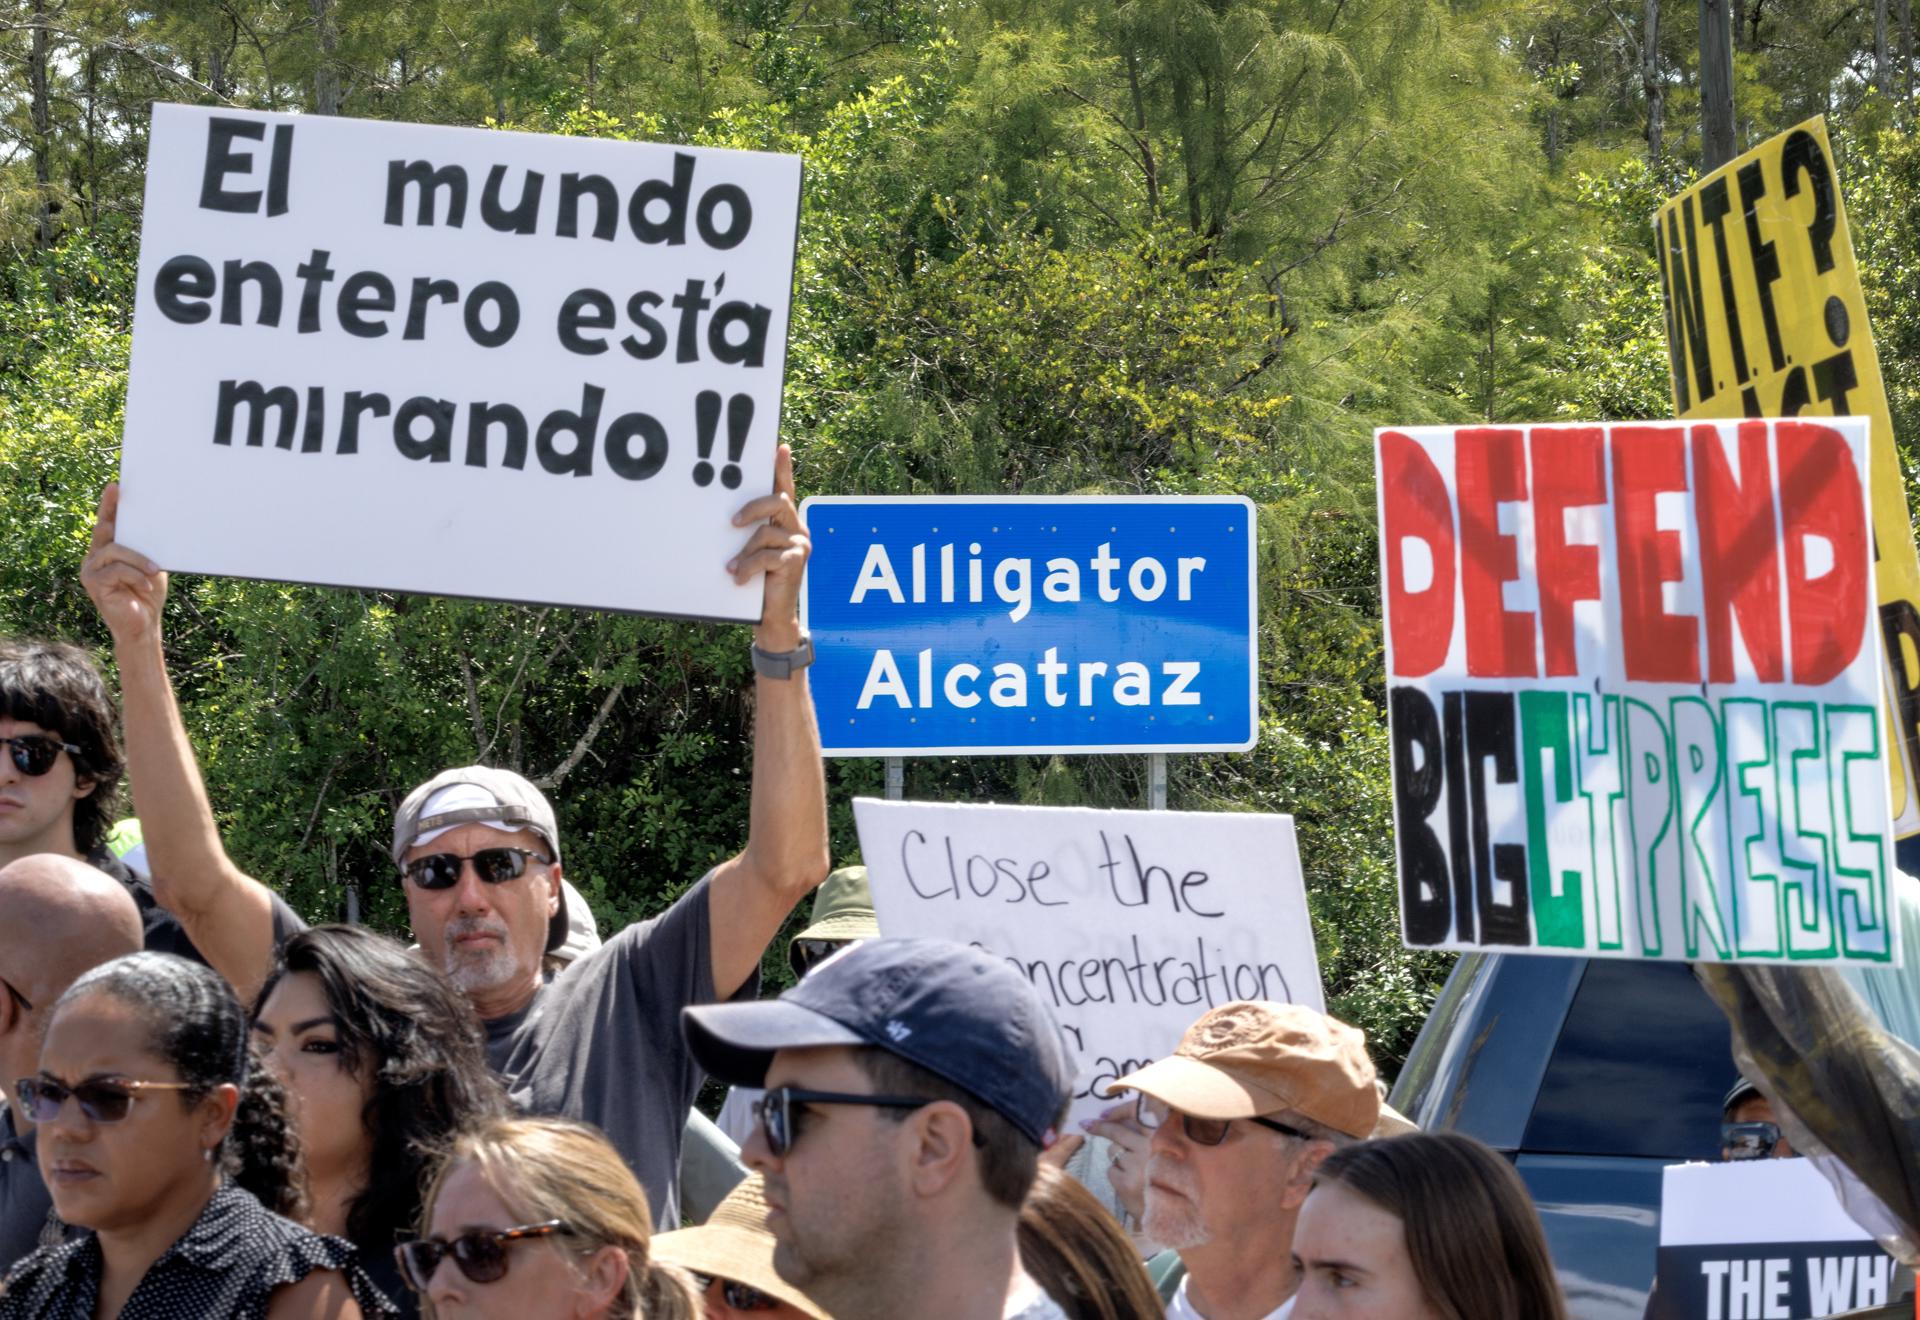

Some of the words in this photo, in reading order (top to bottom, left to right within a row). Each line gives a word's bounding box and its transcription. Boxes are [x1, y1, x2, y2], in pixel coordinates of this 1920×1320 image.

[199, 117, 294, 217] El
[384, 152, 752, 250] mundo
[154, 250, 520, 347] entero
[558, 273, 771, 367] está
[850, 542, 1206, 623] Alligator
[1380, 420, 1867, 684] DEFEND
[856, 647, 1200, 709] Alcatraz
[1391, 687, 1529, 945] BIG
[1519, 689, 1892, 963] CYPRESS
[902, 831, 1067, 905] Close
[1099, 831, 1224, 918] the
[969, 934, 1293, 1010] ncentration
[1702, 1258, 1790, 1320] THE
[1807, 1255, 1897, 1320] WH
